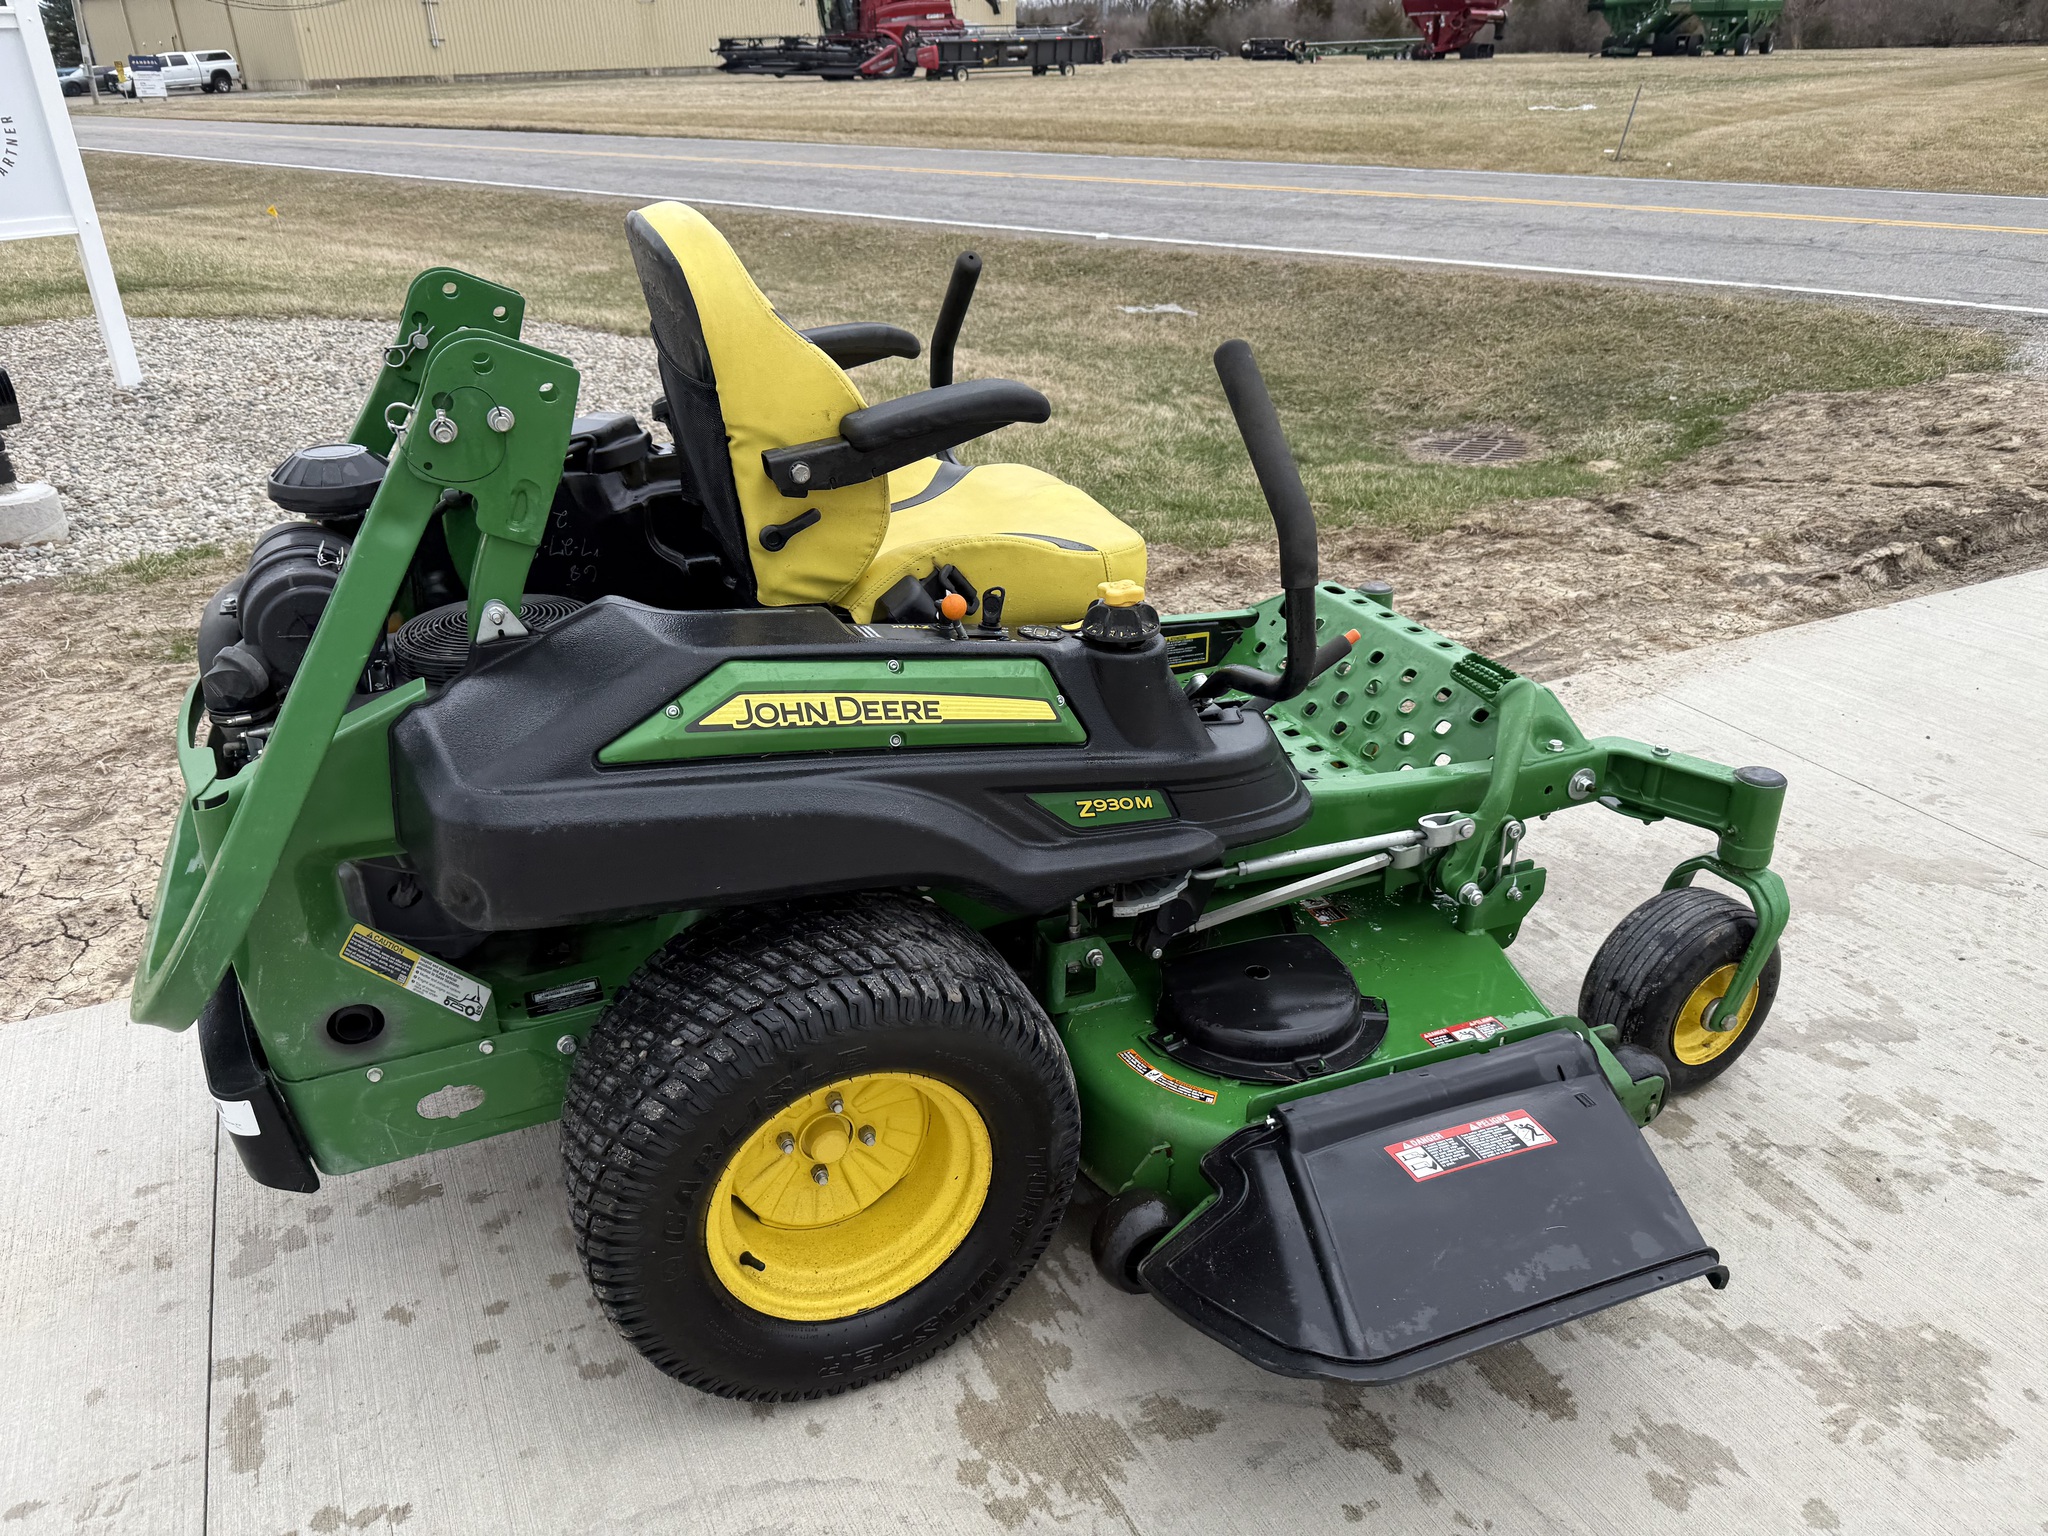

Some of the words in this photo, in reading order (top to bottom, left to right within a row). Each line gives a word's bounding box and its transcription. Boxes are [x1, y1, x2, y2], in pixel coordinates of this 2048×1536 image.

[736, 698, 829, 725] JOHN
[834, 696, 943, 721] DEERE
[1076, 796, 1153, 818] Z930M
[374, 935, 405, 955] CAUTION
[1410, 1132, 1445, 1147] DANGER
[1476, 1114, 1510, 1128] PELIGRO
